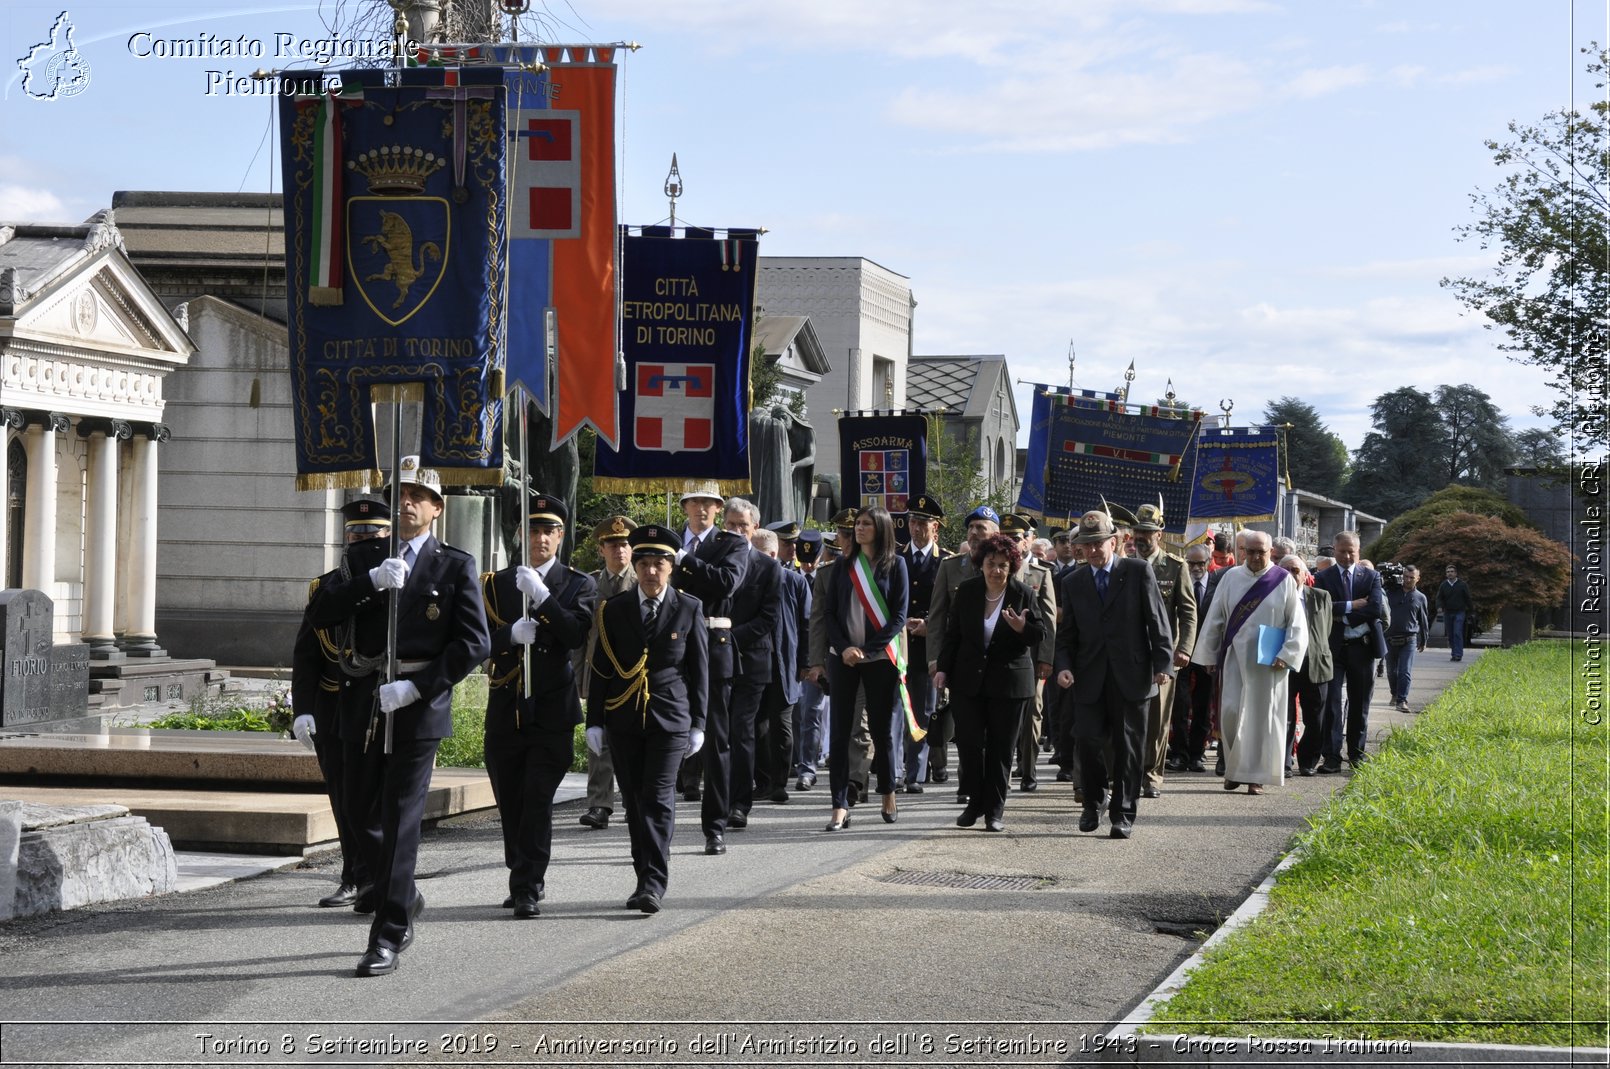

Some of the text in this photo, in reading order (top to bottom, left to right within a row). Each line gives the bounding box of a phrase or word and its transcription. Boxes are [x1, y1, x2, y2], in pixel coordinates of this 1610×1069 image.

[655, 275, 698, 297] CITTÀ
[637, 326, 716, 346] DI TORINO
[383, 337, 398, 357] DI
[404, 337, 474, 358] TORINO
[853, 436, 913, 450] ASSOARMA
[1103, 430, 1147, 443] PIEMONTE
[11, 659, 47, 677] FIORIO
